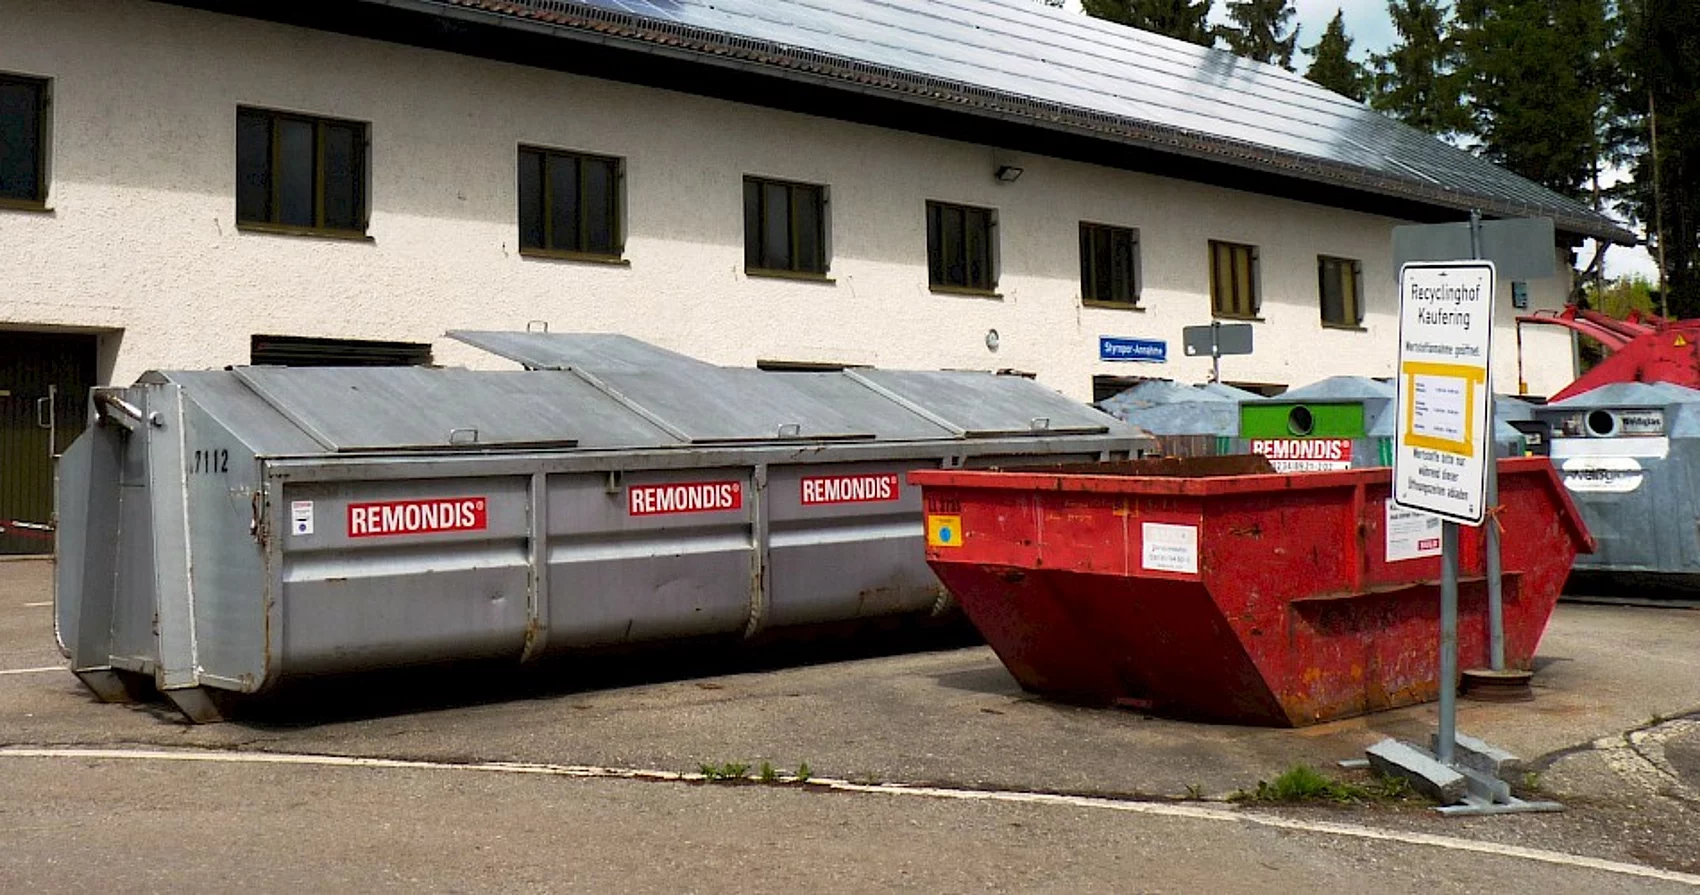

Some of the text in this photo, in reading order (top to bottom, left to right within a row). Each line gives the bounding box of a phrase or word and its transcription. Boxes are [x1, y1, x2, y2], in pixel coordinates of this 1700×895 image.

[1411, 283, 1480, 305] Recyclinghof
[1418, 307, 1470, 330] Kaufering
[194, 449, 229, 473] 7112
